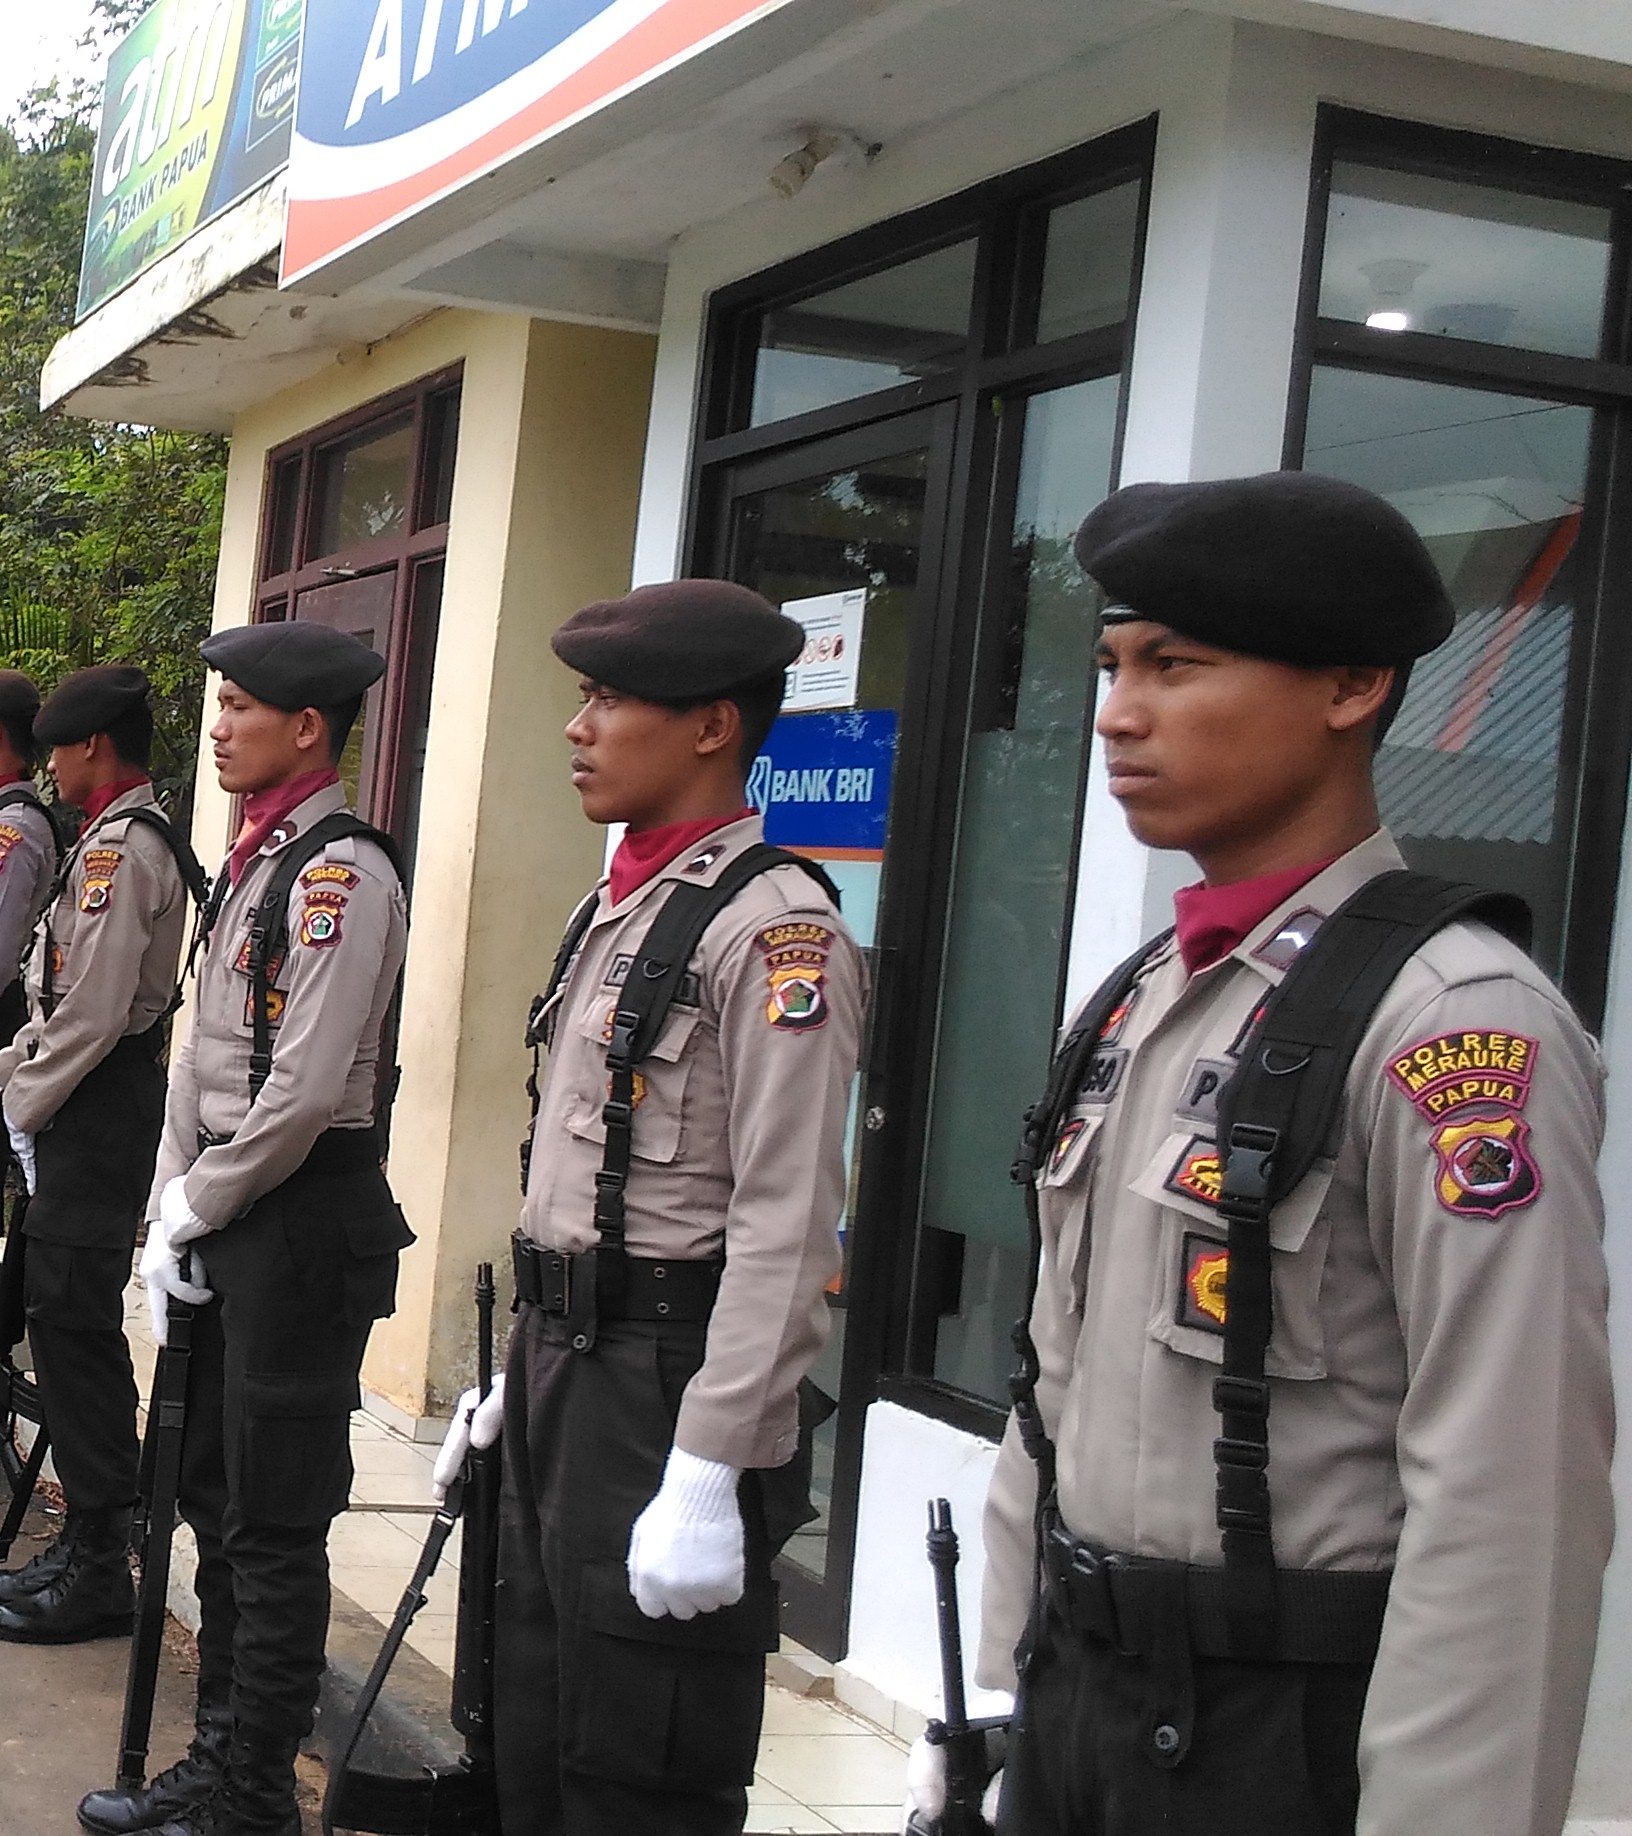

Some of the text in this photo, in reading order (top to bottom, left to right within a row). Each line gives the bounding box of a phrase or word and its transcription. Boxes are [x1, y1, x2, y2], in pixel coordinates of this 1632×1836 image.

[120, 130, 208, 230] BANK PAPUA
[770, 767, 875, 802] BANK BRI
[86, 850, 119, 860] POLRES
[763, 923, 828, 941] POLRES
[770, 950, 822, 965] PAPUA
[1394, 1033, 1528, 1078] POLRES
[1407, 1049, 1526, 1092] MERAUKE
[1427, 1080, 1515, 1112] PAPUA
